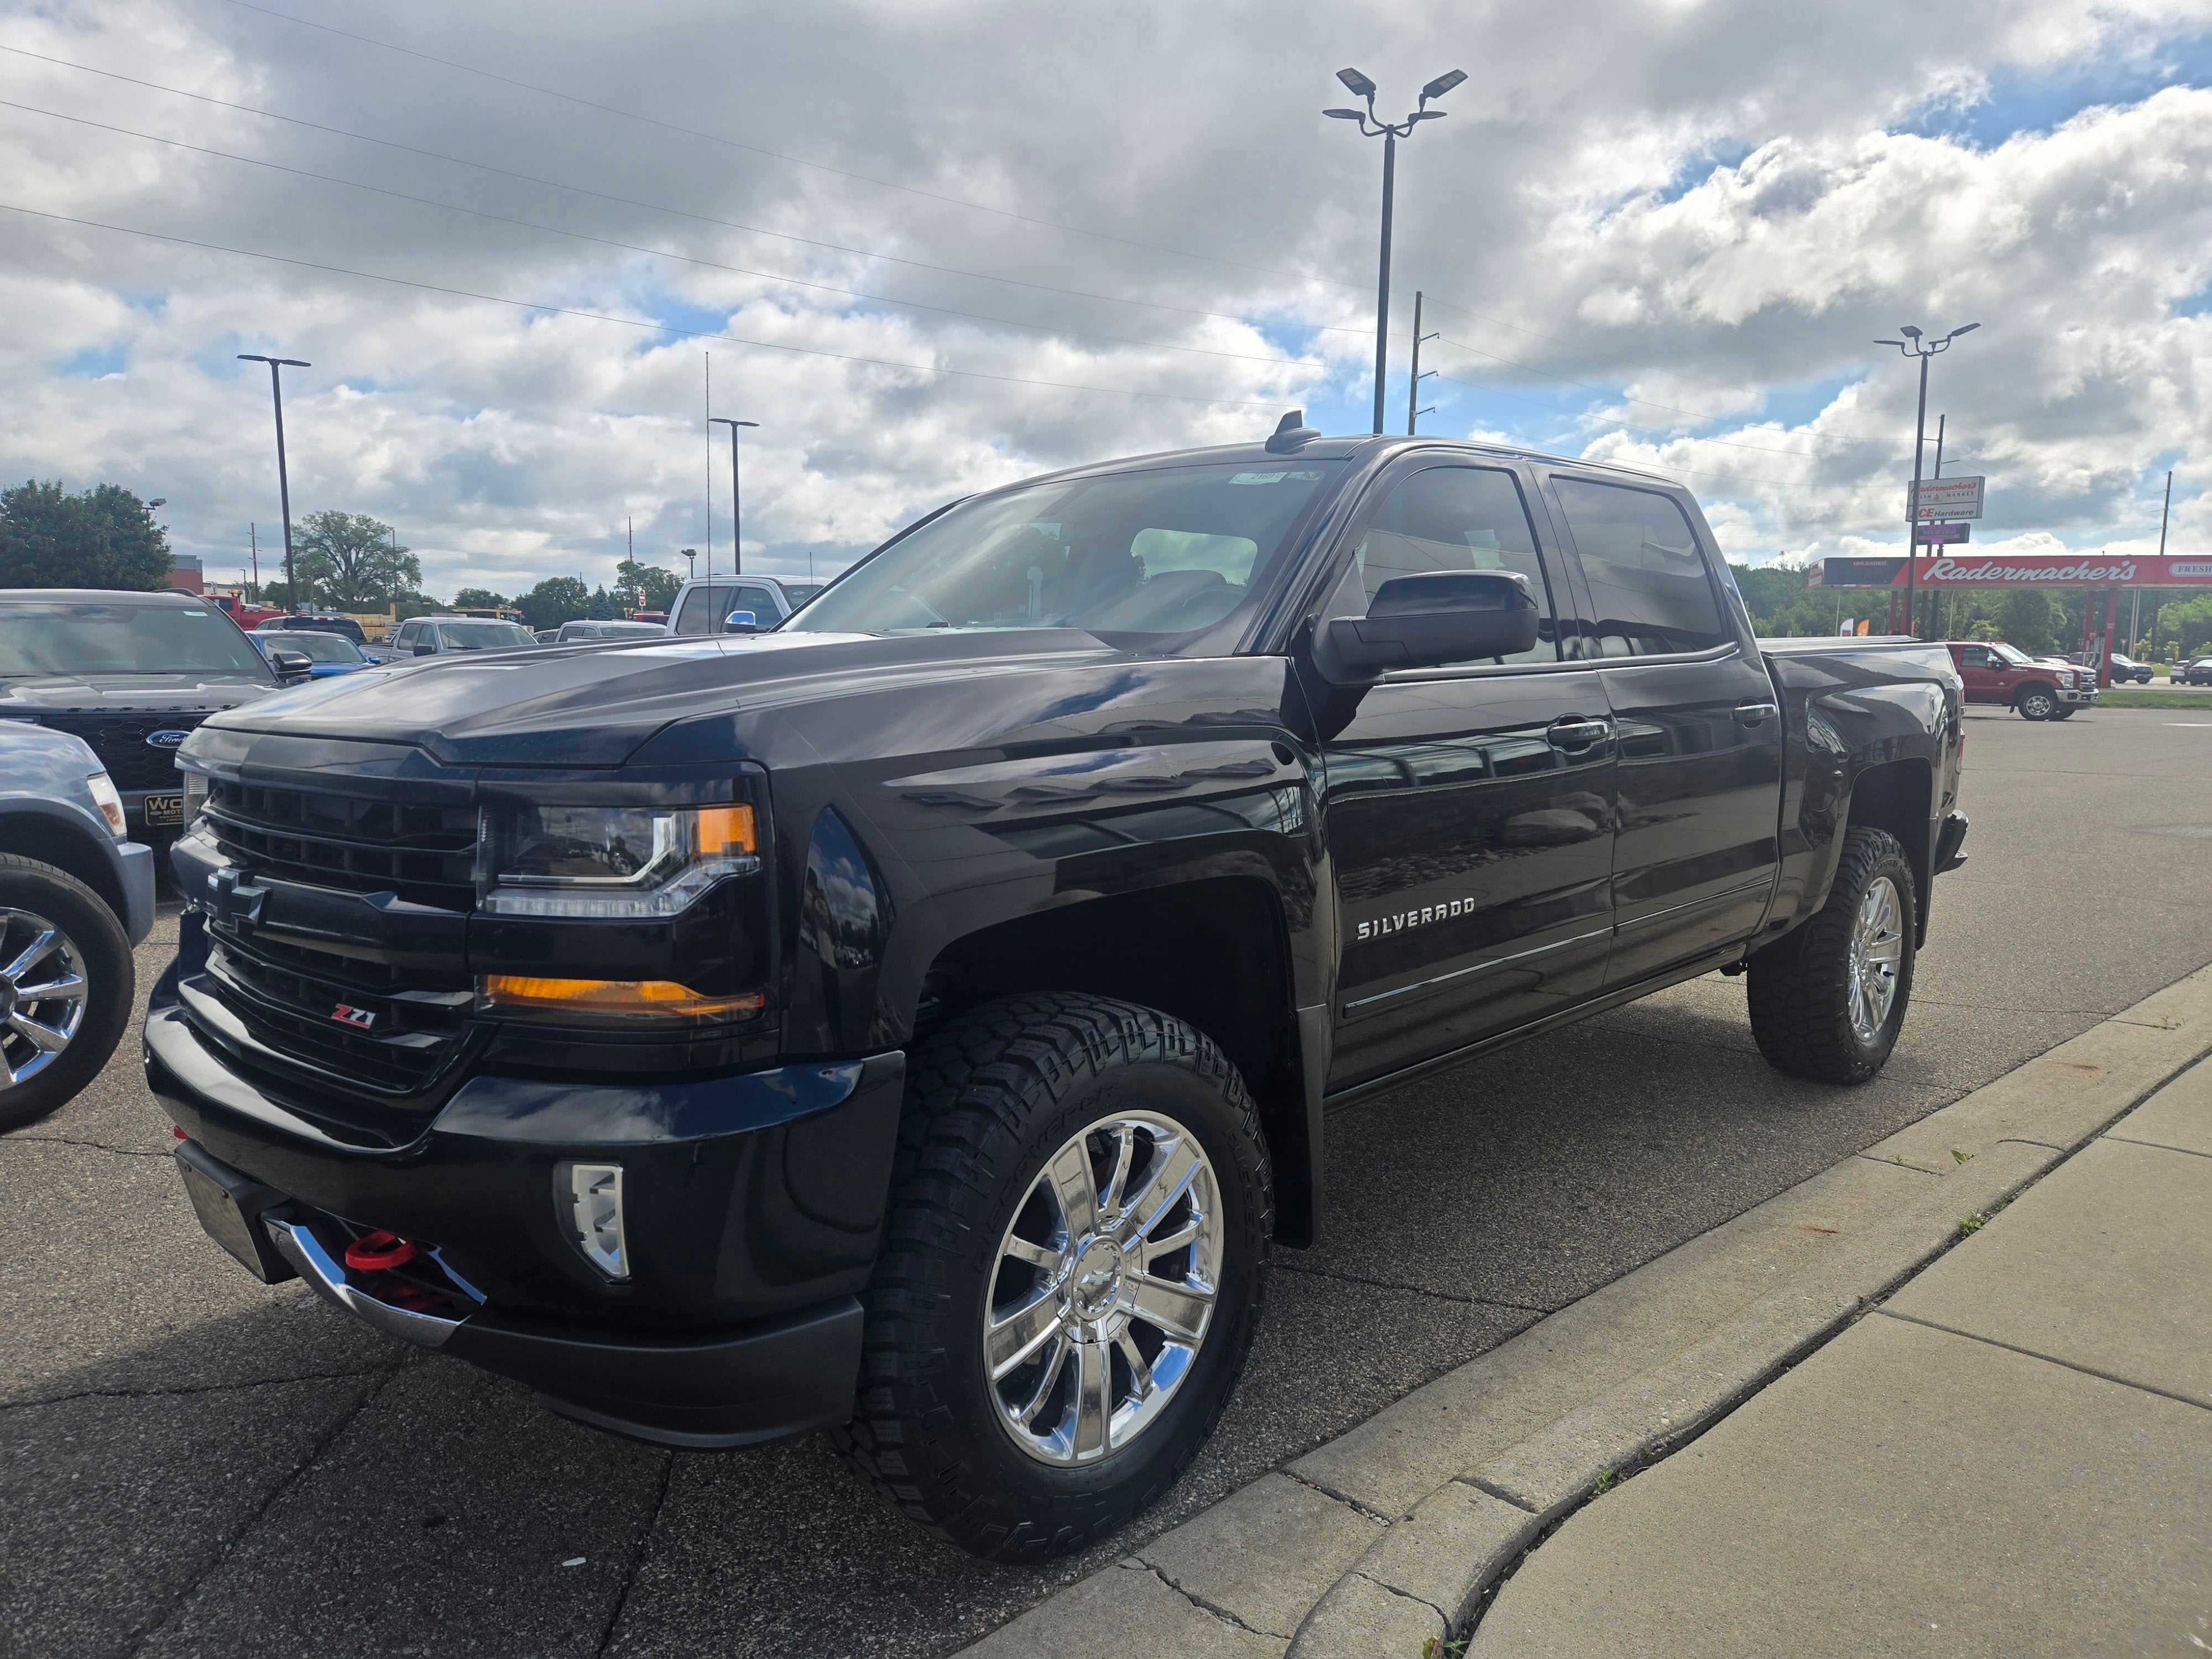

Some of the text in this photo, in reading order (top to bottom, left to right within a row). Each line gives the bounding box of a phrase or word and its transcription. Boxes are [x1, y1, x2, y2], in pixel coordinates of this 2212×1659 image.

[1911, 482, 1977, 493] adermacher's
[1922, 559, 2137, 581] Radermacher's
[1358, 897, 1475, 940] SILVERADO
[331, 1003, 376, 1030] Z71
